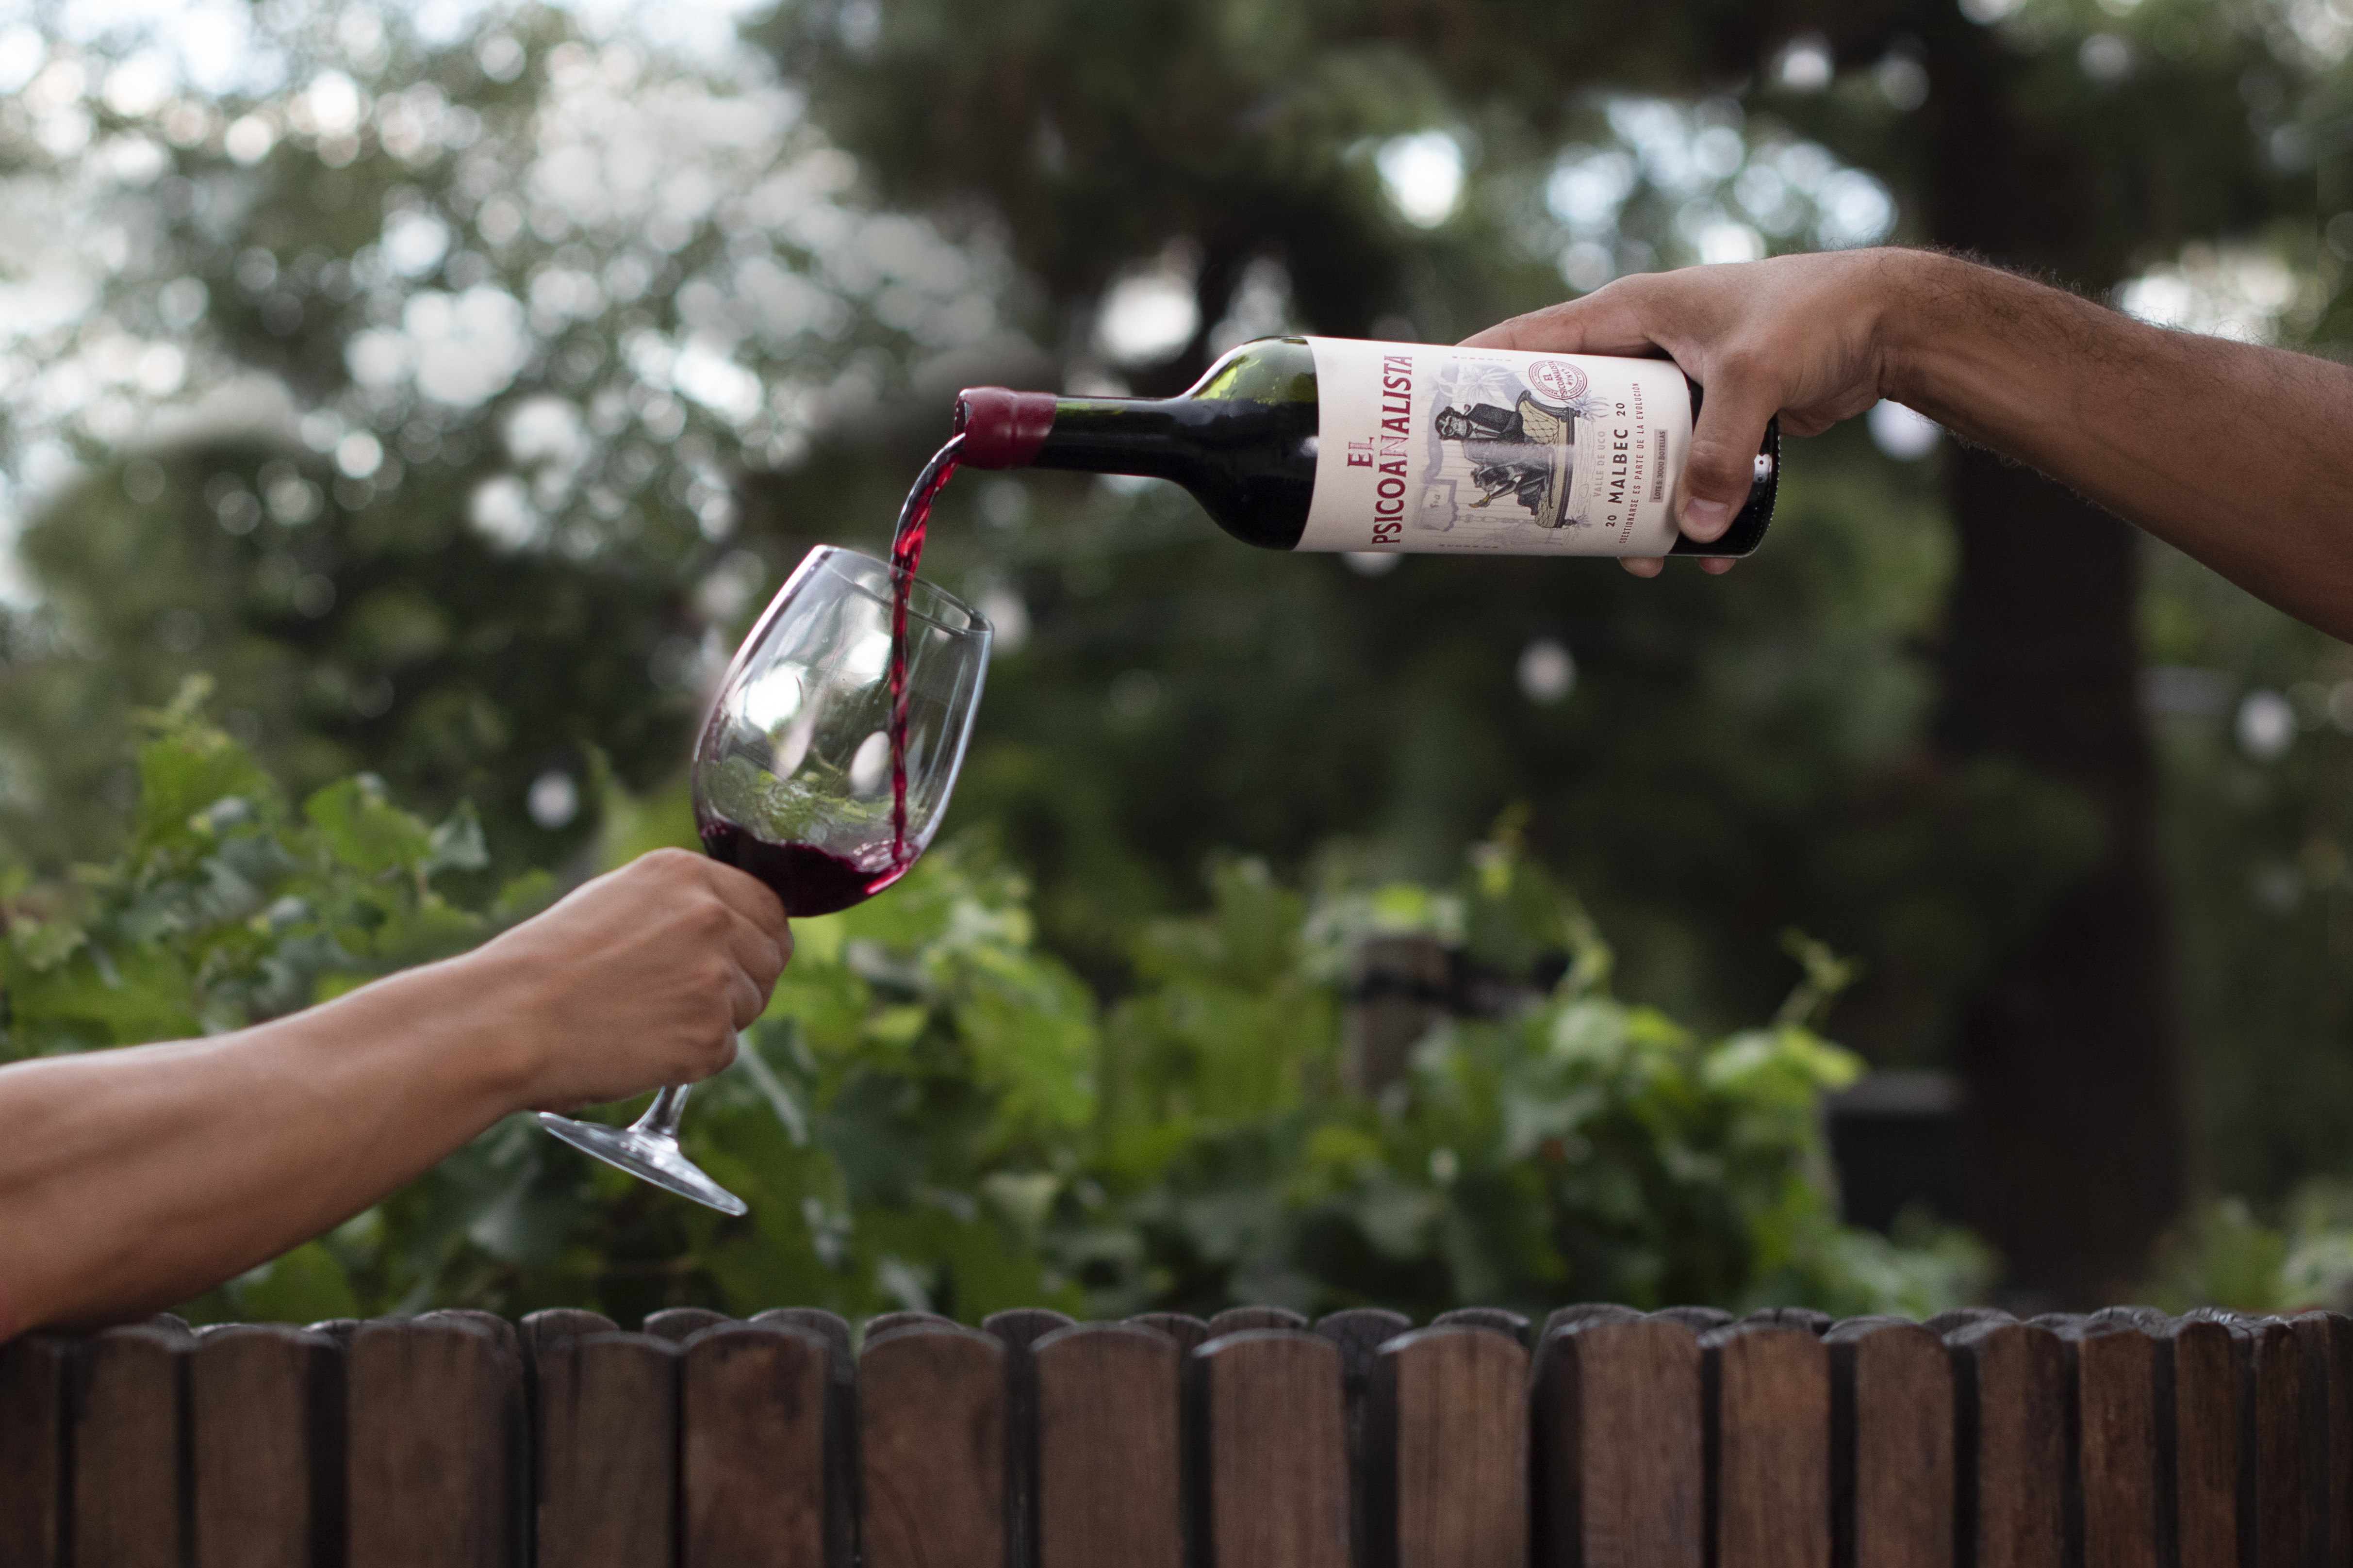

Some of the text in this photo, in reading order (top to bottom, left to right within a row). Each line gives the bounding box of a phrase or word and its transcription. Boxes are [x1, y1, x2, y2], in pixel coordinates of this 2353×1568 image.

[1548, 360, 1567, 398] PSICOANALISTA
[1561, 369, 1574, 386] WINES
[1347, 437, 1374, 467] EL
[1371, 355, 1412, 544] PSICOANALISTA
[1657, 431, 1666, 460] BOTELLAS
[1597, 455, 1605, 466] DE
[1605, 403, 1628, 527] 20 MALBEC 20
[1618, 383, 1644, 543] CUESTIONARSE ES PARTE DE LA EVOLUCIÓN
[1656, 461, 1665, 478] 3000
[1593, 471, 1604, 497] VALLE
[1653, 485, 1662, 500] LOTE
